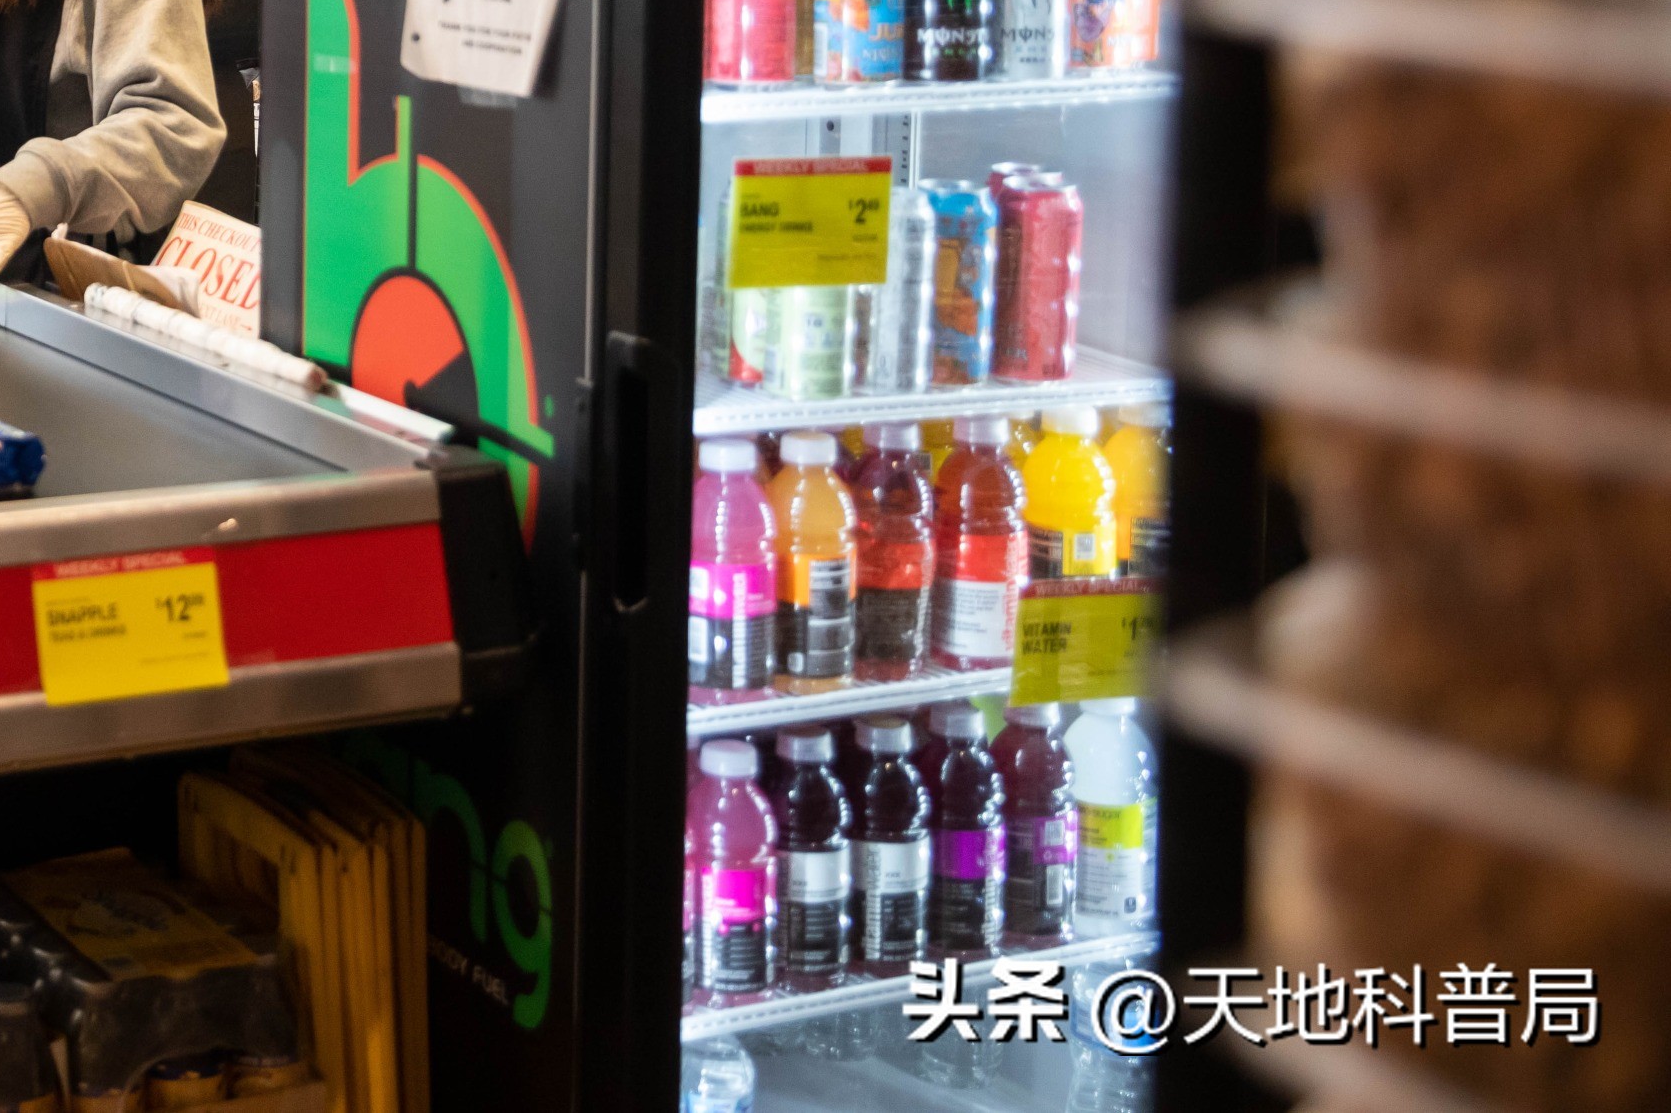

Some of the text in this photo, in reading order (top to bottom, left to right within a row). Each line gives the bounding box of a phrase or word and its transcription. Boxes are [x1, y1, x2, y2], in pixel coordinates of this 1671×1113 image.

[177, 212, 199, 232] THIS
[46, 602, 118, 626] SNAPPLE
[1022, 621, 1072, 637] VITAMIN
[1021, 638, 1067, 655] WATER
